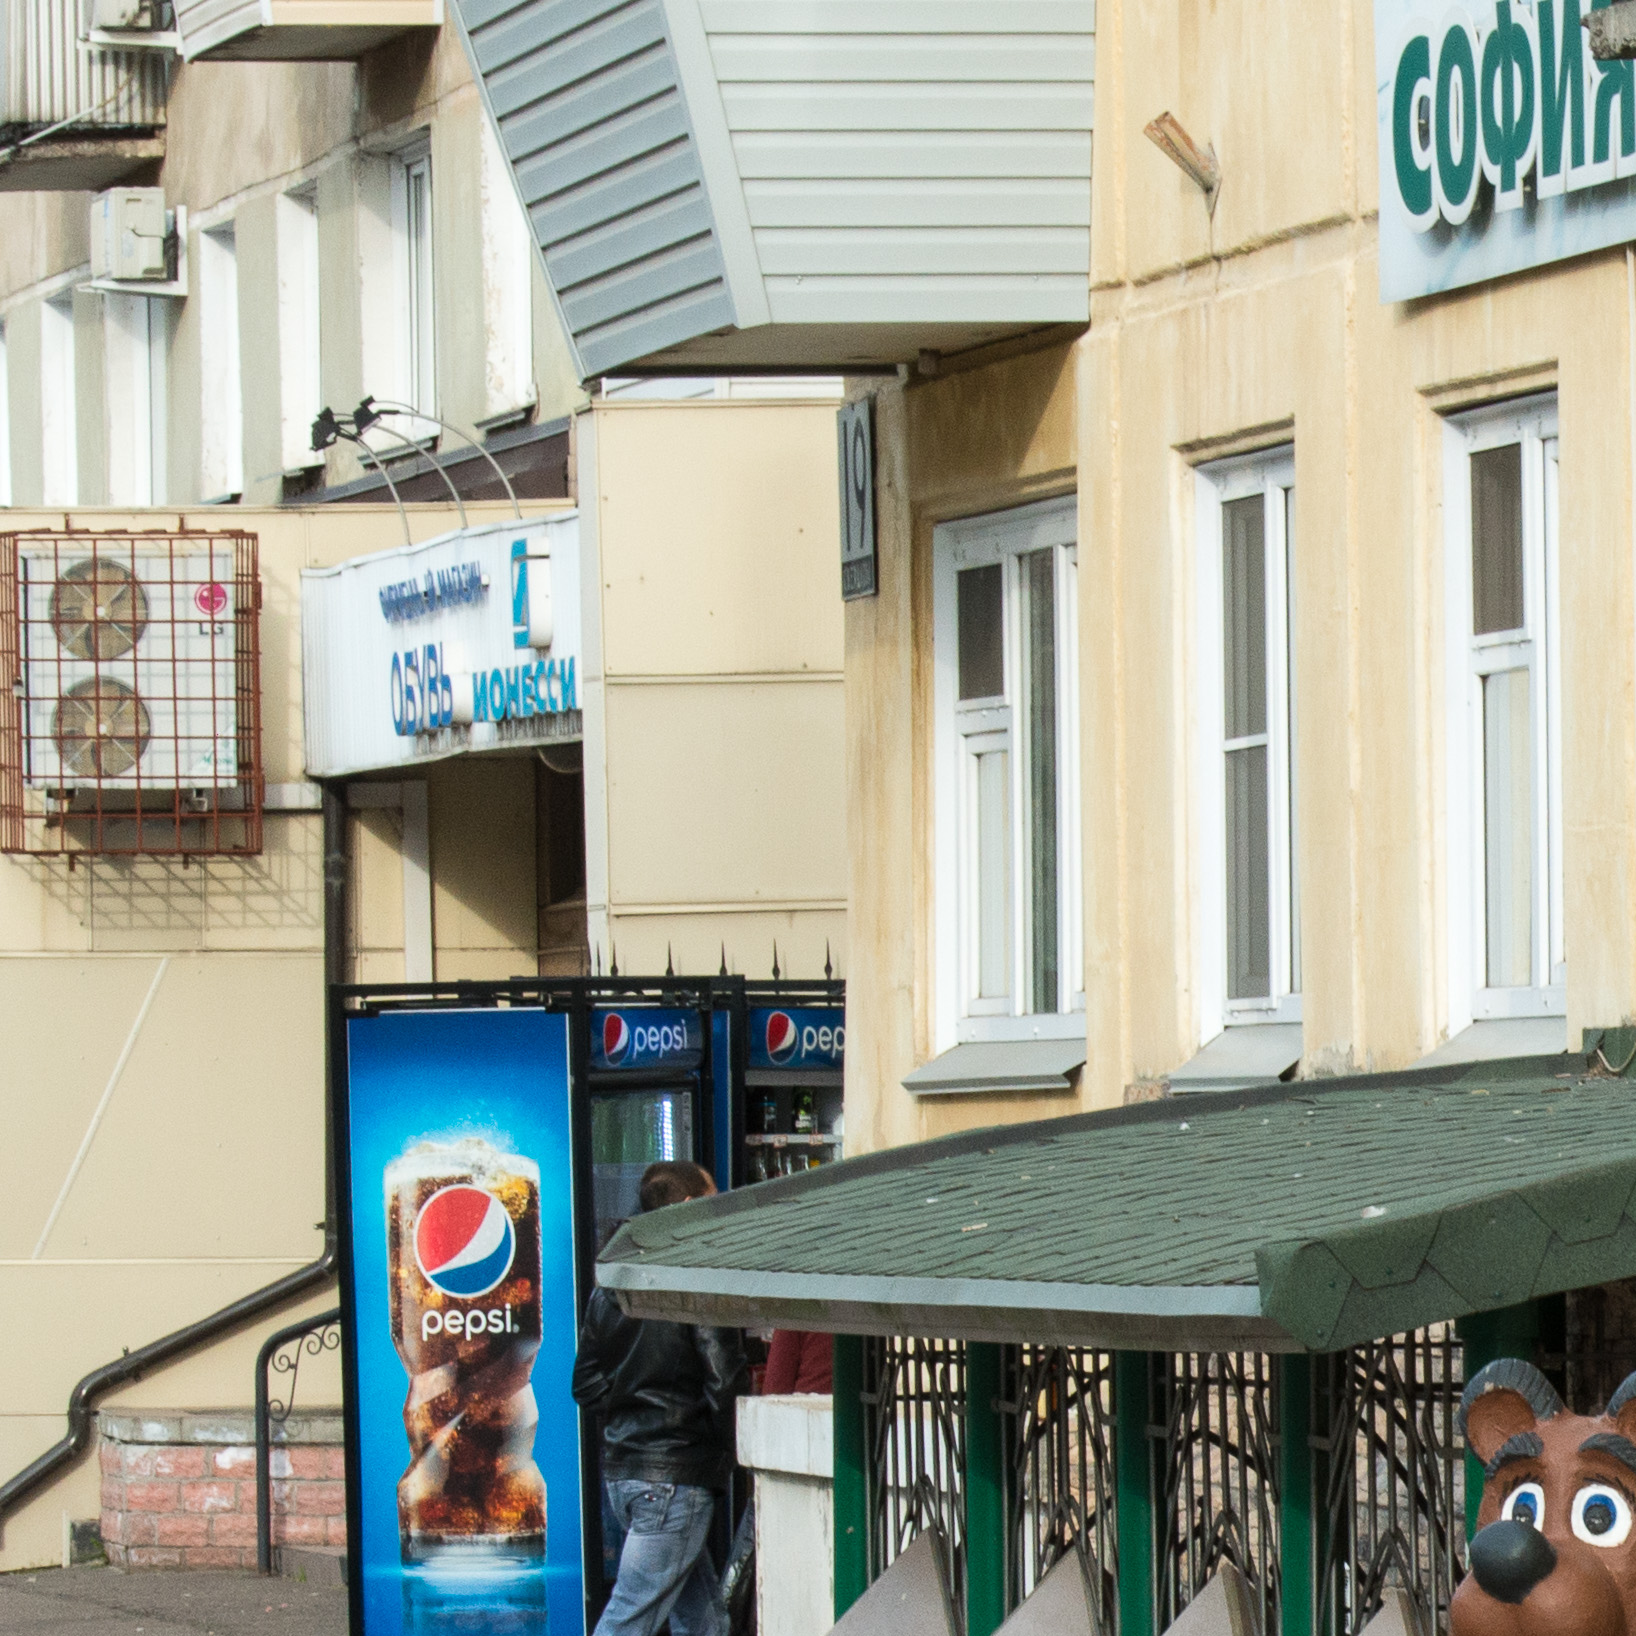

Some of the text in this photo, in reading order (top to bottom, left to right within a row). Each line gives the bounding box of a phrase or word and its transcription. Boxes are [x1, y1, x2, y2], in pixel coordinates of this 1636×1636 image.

[843, 416, 867, 553] 19
[198, 622, 225, 635] LG
[391, 642, 577, 737] ОБУВЬ ИОНЕССИ
[633, 1018, 688, 1060] pepsi
[421, 1302, 512, 1342] pepsi
